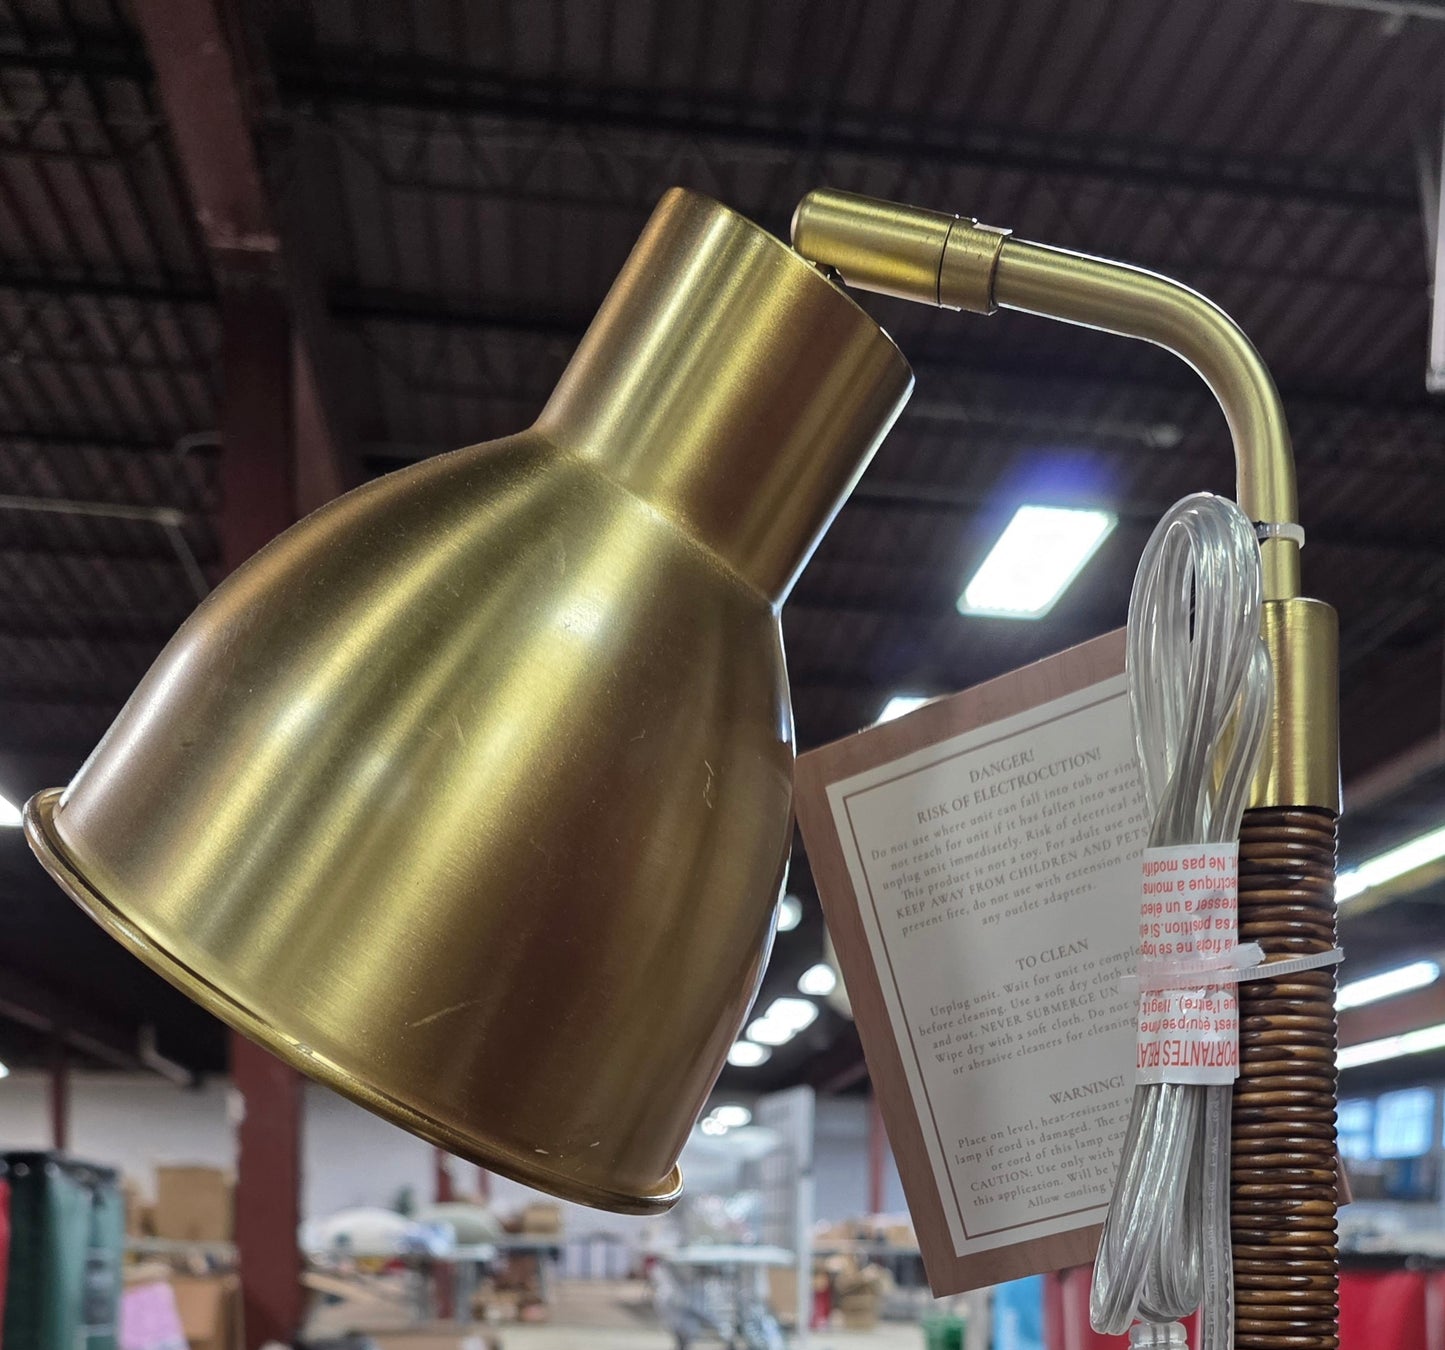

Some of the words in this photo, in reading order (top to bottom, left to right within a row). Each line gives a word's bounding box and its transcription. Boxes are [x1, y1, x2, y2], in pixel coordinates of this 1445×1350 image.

[916, 803, 948, 824] RISK
[951, 794, 969, 811] OF
[973, 748, 1100, 803] ELECTROCUTION!
[969, 749, 1034, 783] DANGER!
[870, 849, 886, 860] Do
[890, 840, 908, 854] not
[911, 834, 929, 846] use
[933, 820, 965, 838] where
[969, 809, 992, 826] unit
[997, 803, 1016, 816] can
[1020, 791, 1040, 808] fall
[1044, 785, 1068, 799] into
[1072, 774, 1092, 789] tub
[1096, 770, 1109, 781] or
[890, 857, 908, 871] not
[912, 844, 941, 863] reach
[945, 839, 961, 852] for
[966, 829, 988, 844] unit
[992, 822, 1001, 835] if
[1006, 819, 1015, 831] it
[1018, 812, 1038, 826] has
[1041, 799, 1075, 818] fallen
[1079, 789, 1104, 805] into
[882, 871, 921, 890] unplug
[923, 862, 946, 877] unit
[1025, 824, 1051, 841] Risk
[1055, 818, 1067, 830] of
[1071, 797, 1126, 825] electrical
[900, 886, 923, 900] This
[927, 871, 970, 894] product
[974, 866, 983, 876] is
[987, 858, 1006, 872] not
[1045, 839, 1064, 852] For
[1069, 825, 1099, 844] adult
[1104, 819, 1123, 832] use
[1182, 854, 1205, 870] pas
[1209, 856, 1225, 872] Ne
[896, 900, 925, 919] KEEP
[931, 887, 963, 908] AWAY
[968, 873, 1005, 895] FROM
[1009, 850, 1077, 880] CHILDREN
[1083, 839, 1111, 857] AND
[1115, 826, 1147, 846] PETS
[1143, 881, 1173, 896] moins
[901, 914, 942, 937] prevent
[972, 899, 986, 911] do
[989, 892, 1008, 905] not
[1012, 885, 1030, 898] use
[1034, 873, 1061, 889] with
[1065, 856, 1121, 880] extension
[981, 912, 1000, 925] any
[1004, 899, 1039, 917] outlet
[1165, 901, 1180, 913] un
[1015, 955, 1036, 970] TO
[1039, 938, 1088, 963] CLEAN
[1159, 943, 1172, 954] se
[1176, 942, 1192, 954] ne
[918, 1020, 953, 1036] before
[1009, 997, 1030, 1009] Use
[1044, 984, 1064, 999] soft
[1068, 979, 1087, 992] dry
[1091, 967, 1121, 984] cloth
[929, 999, 970, 1016] Unplug
[1002, 980, 1029, 993] Wait
[1032, 974, 1049, 986] for
[1054, 965, 1078, 979] unit
[1082, 961, 1094, 971] to
[932, 1033, 951, 1049] and
[980, 1014, 1022, 1034] NEVER
[1026, 991, 1095, 1020] SUBMERGE
[934, 1050, 963, 1063] Wipe
[966, 1043, 984, 1055] dry
[988, 1033, 1013, 1047] with
[1026, 1023, 1046, 1037] soft
[1087, 1008, 1104, 1019] Do
[1108, 1001, 1128, 1013] not
[952, 1065, 963, 1075] or
[967, 1051, 1012, 1070] abrasive
[1016, 1037, 1062, 1056] cleaners
[1065, 1031, 1082, 1043] for
[1049, 1075, 1124, 1103] WARNING!
[954, 1152, 981, 1165] lamp
[985, 1145, 993, 1157] if
[997, 1138, 1022, 1153] cord
[1025, 1137, 1035, 1146] is
[1094, 1116, 1114, 1127] The
[957, 1135, 986, 1148] Place
[990, 1131, 1004, 1140] on
[1040, 1099, 1119, 1126] heat-resistant
[970, 1168, 1032, 1191] CAUTION:
[1035, 1164, 1056, 1174] Use
[1060, 1155, 1084, 1169] only
[1088, 1147, 1114, 1161] with
[991, 1162, 1002, 1171] or
[1006, 1151, 1031, 1167] cord
[1035, 1147, 1046, 1160] of
[1050, 1143, 1072, 1156] this
[1074, 1136, 1103, 1149] lamp
[973, 1194, 994, 1206] this
[1066, 1168, 1091, 1182] Will
[1094, 1166, 1108, 1176] be
[1027, 1194, 1059, 1208] Allow
[1063, 1183, 1106, 1199] cooling
